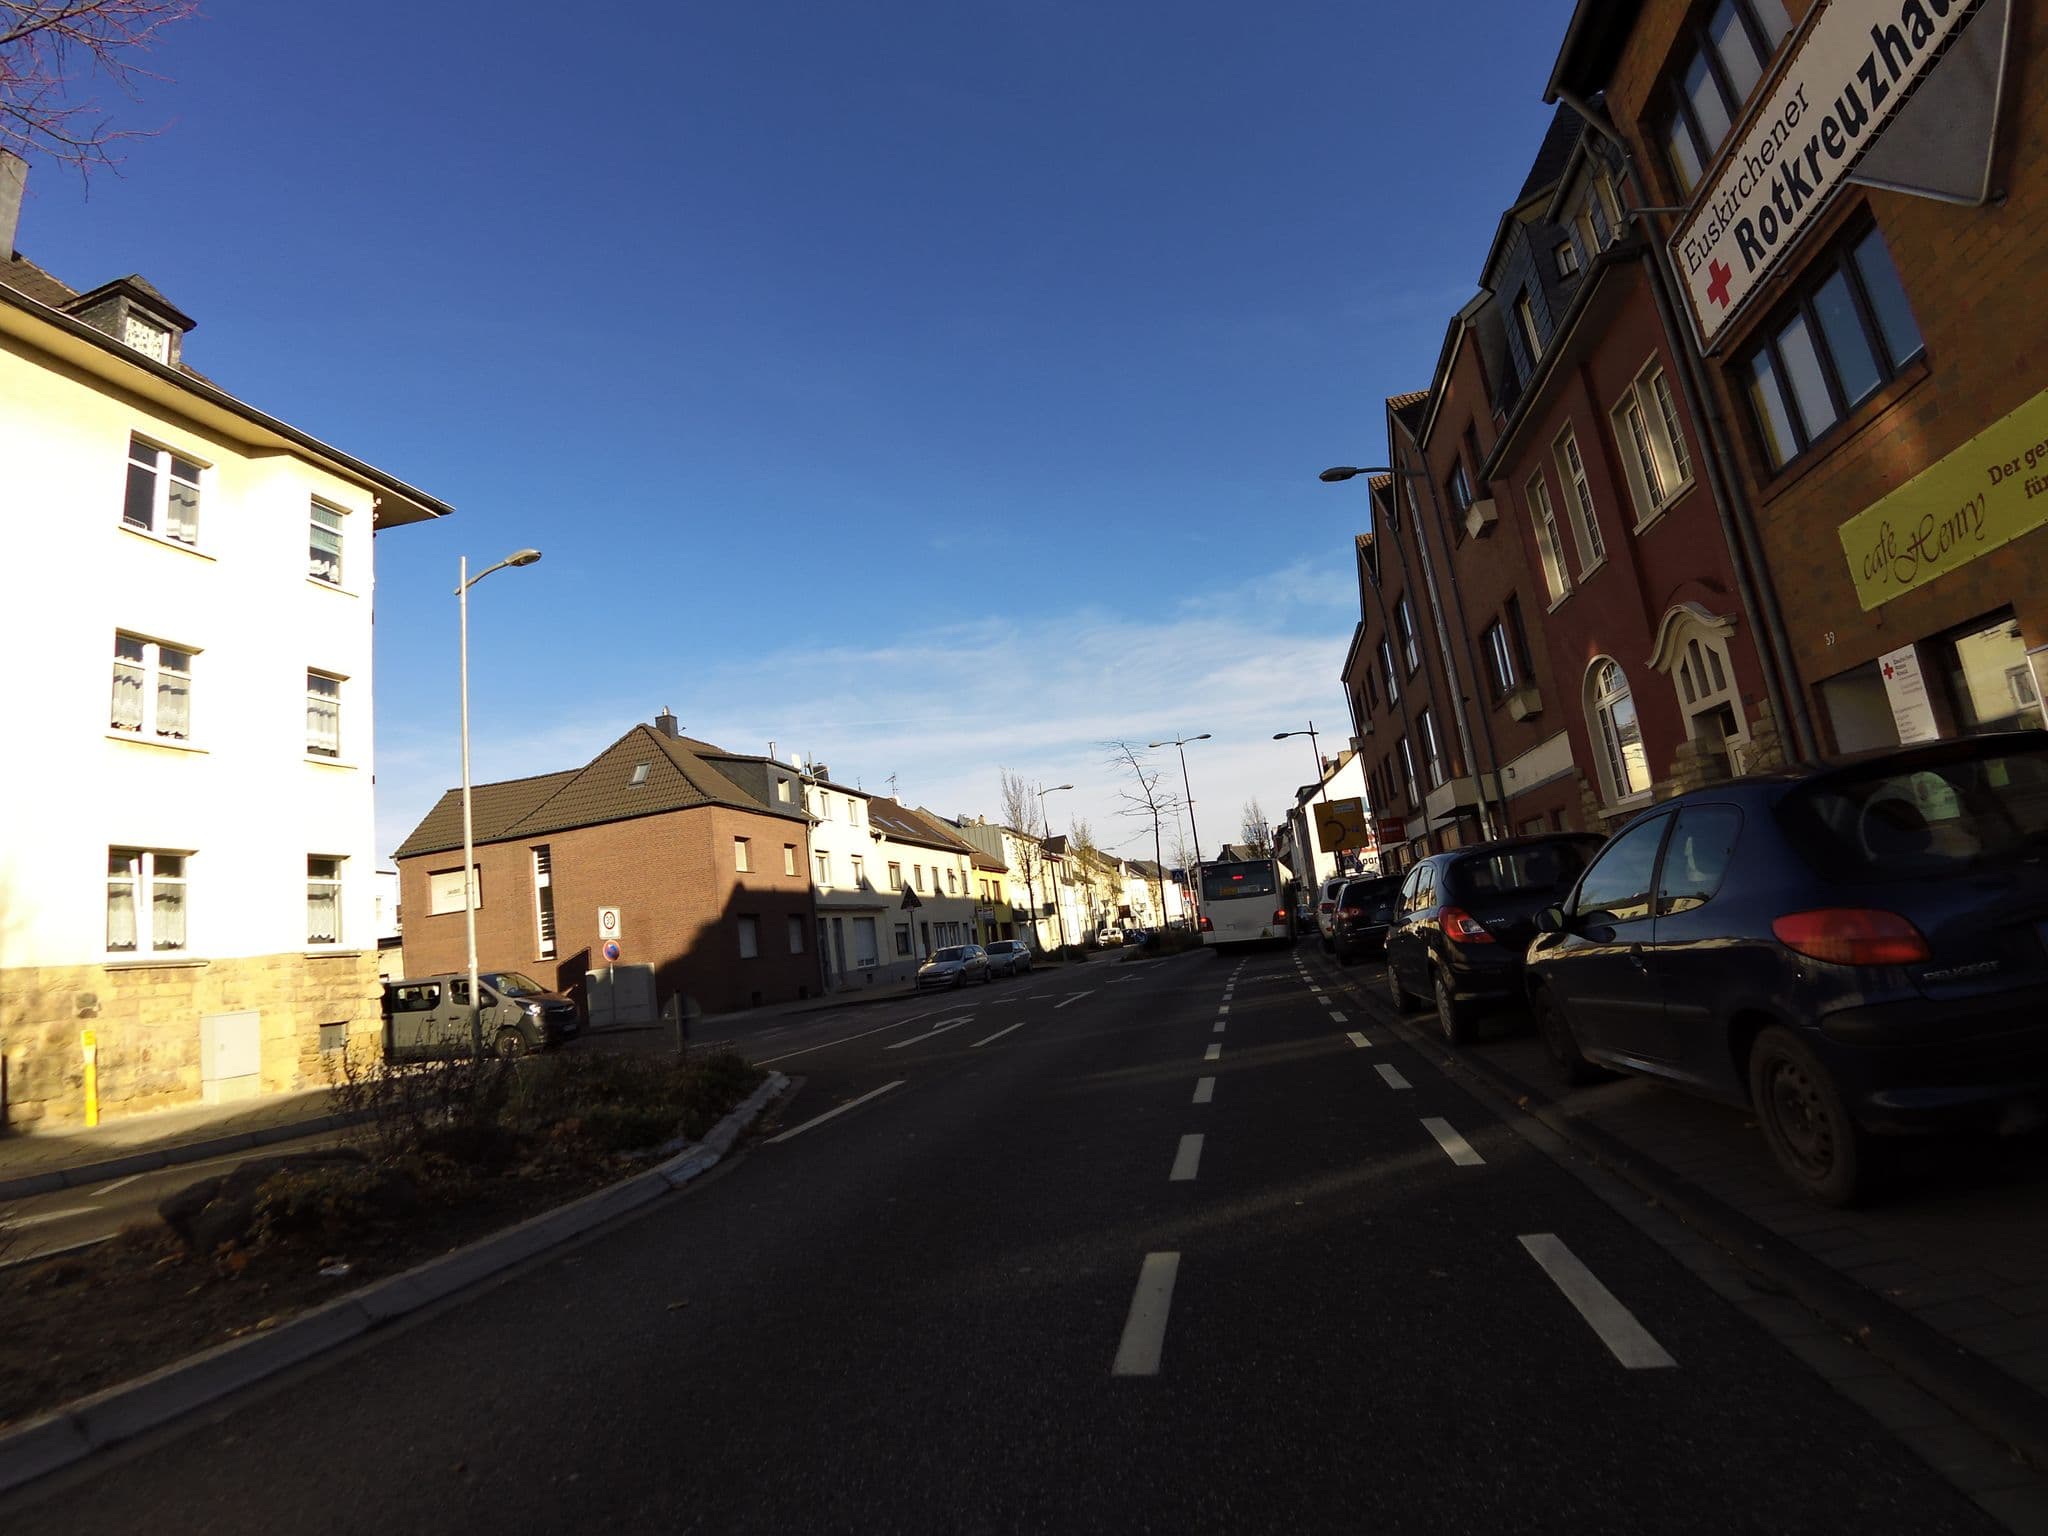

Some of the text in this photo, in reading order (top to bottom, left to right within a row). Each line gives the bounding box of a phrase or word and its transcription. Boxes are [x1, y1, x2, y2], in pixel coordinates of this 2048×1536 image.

[1683, 82, 1810, 276] Euskirchener
[1987, 457, 2021, 486] Der
[1863, 492, 1986, 584] café Henry
[1824, 631, 1836, 646] 39
